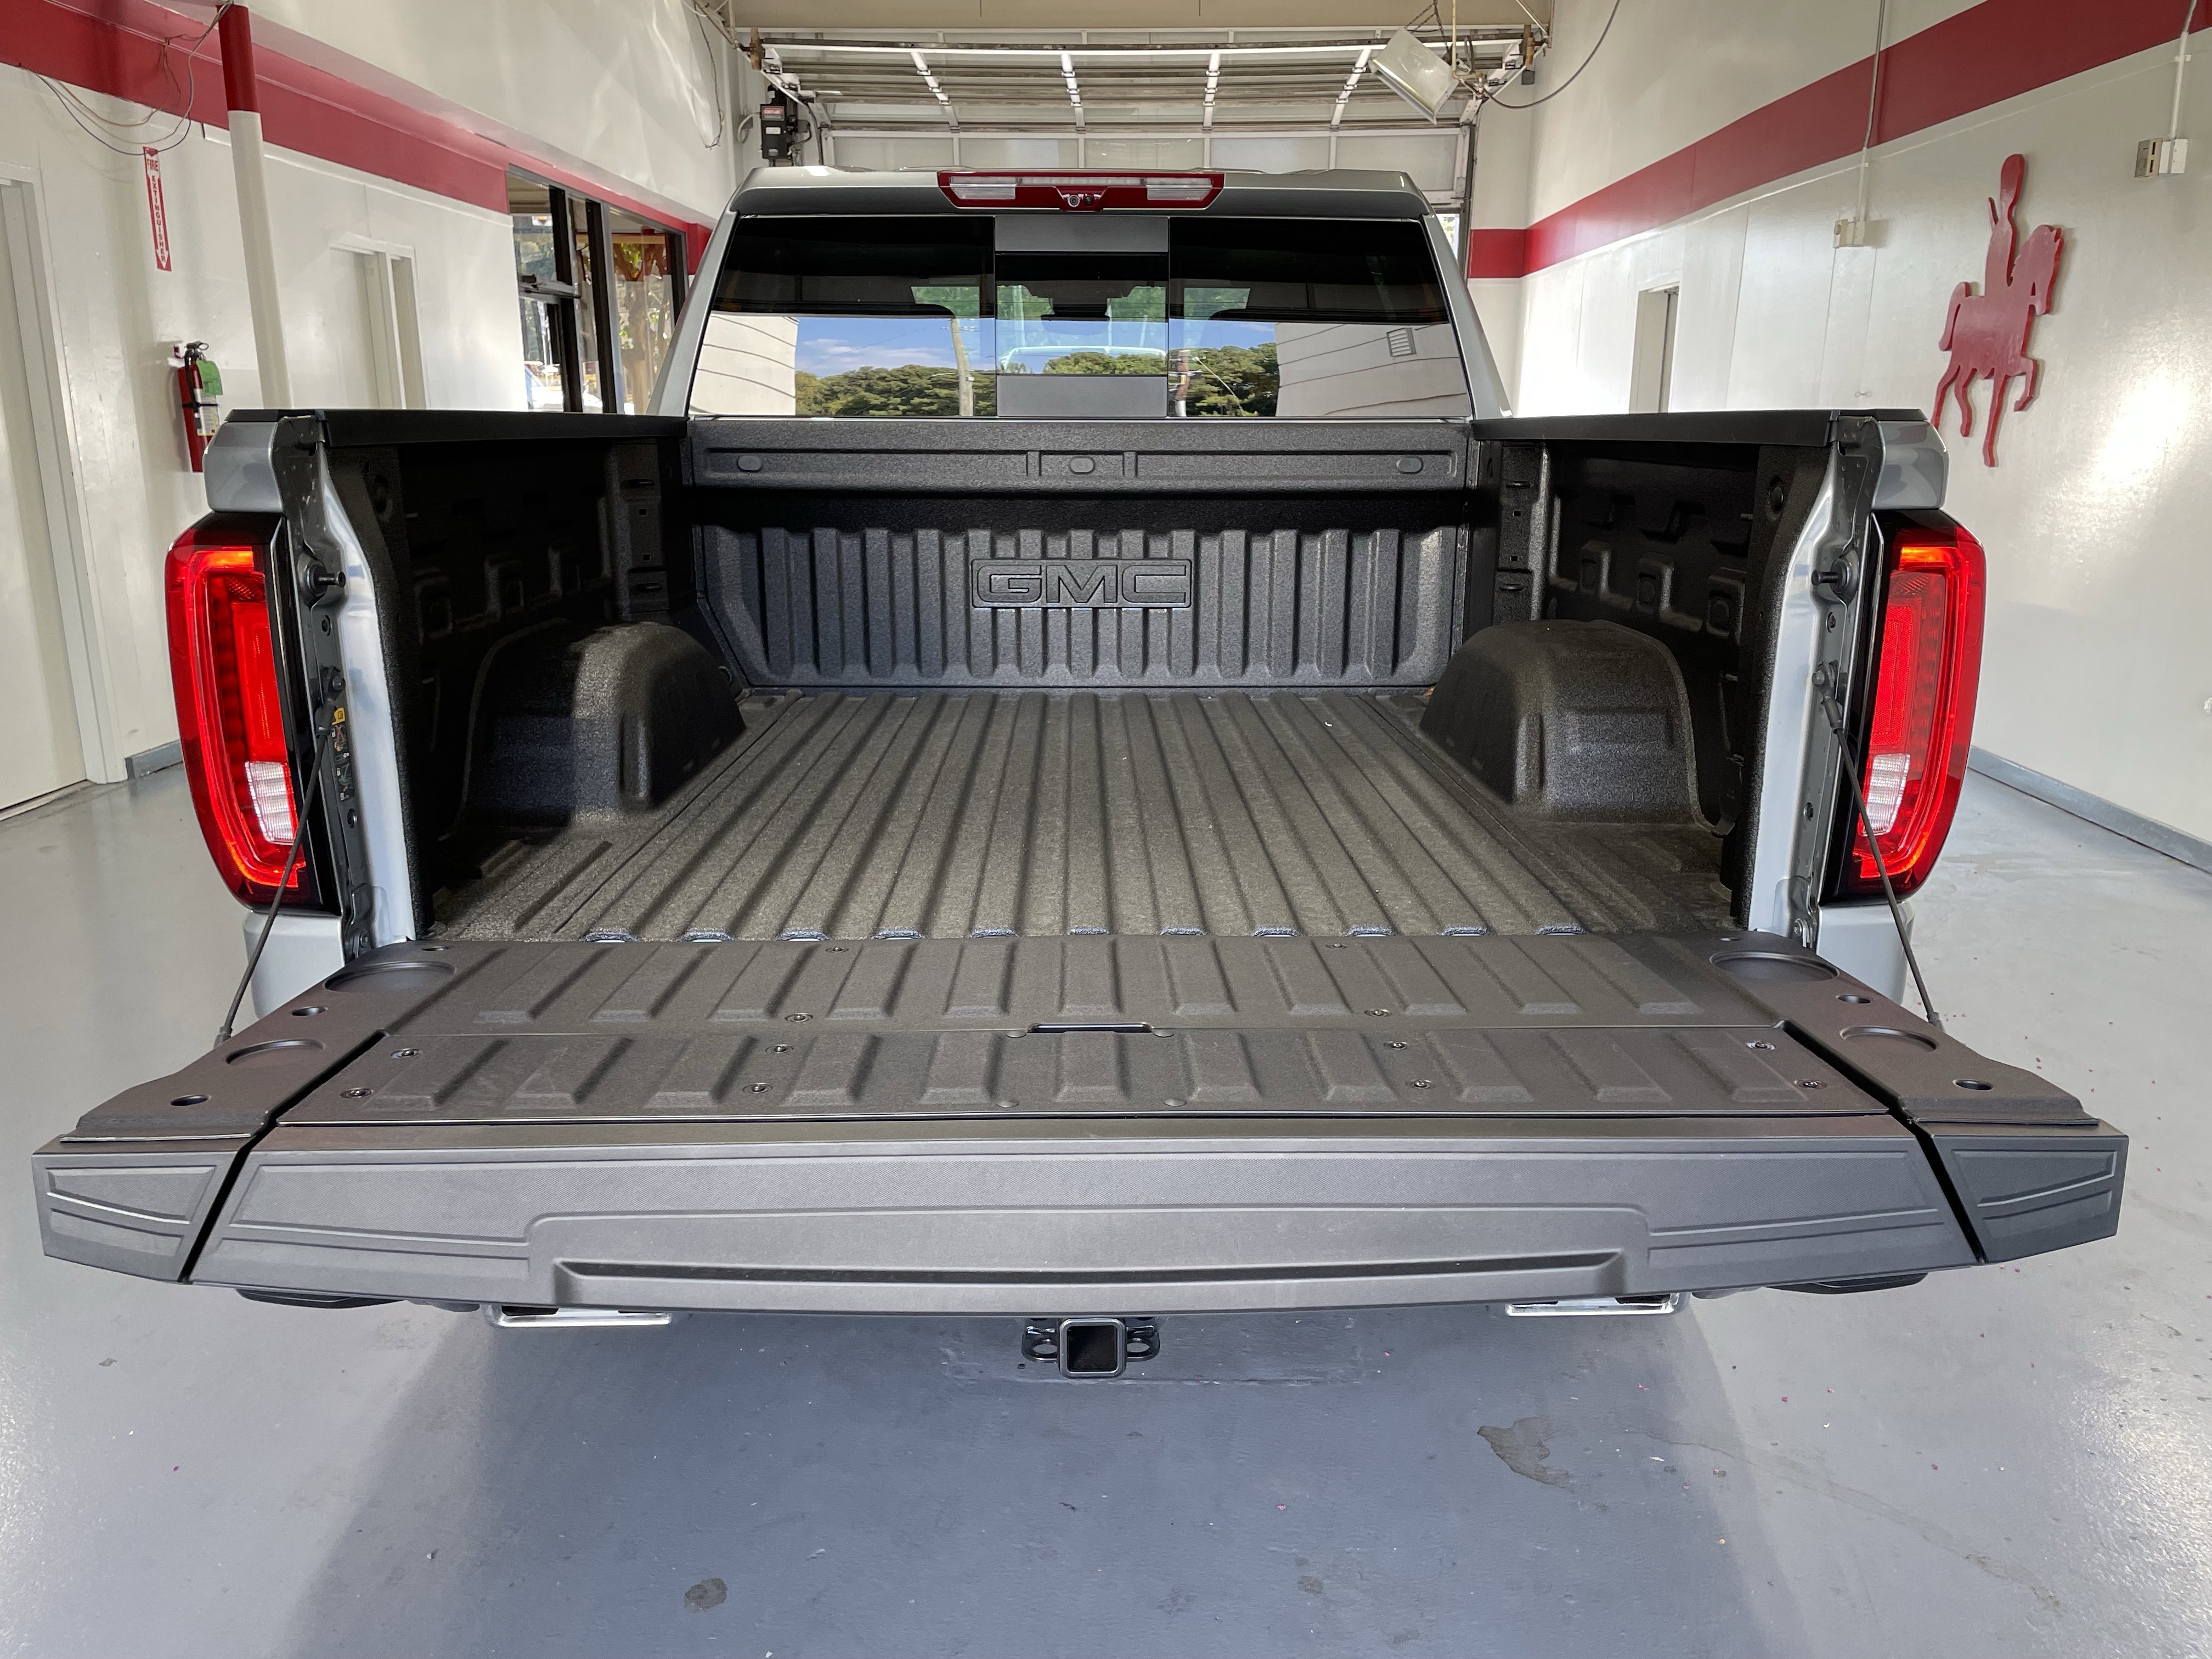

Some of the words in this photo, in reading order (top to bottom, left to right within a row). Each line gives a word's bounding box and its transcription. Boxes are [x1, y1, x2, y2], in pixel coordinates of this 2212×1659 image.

[147, 159, 159, 171] FIRE
[151, 175, 166, 262] EXTINGUISHER
[977, 565, 1186, 603] GMC
